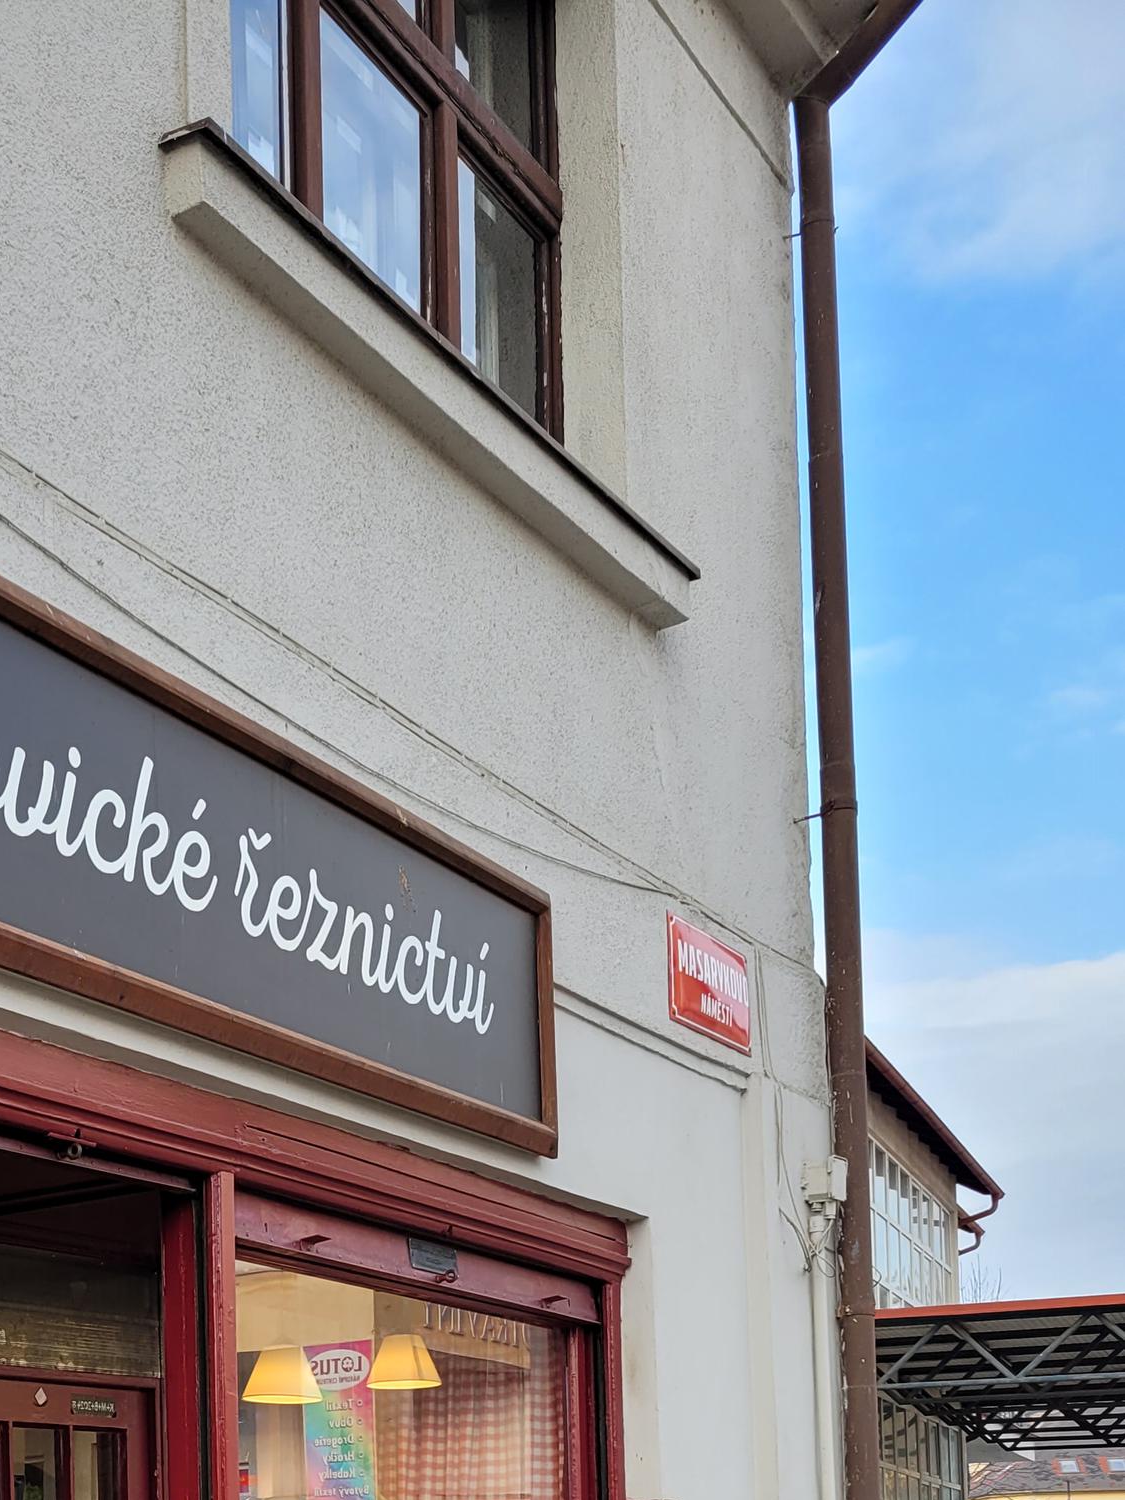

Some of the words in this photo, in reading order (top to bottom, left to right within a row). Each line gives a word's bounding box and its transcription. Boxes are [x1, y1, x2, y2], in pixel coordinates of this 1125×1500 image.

[234, 826, 496, 1035] řeznictví
[677, 938, 749, 1007] MASARYKOVO
[700, 992, 734, 1028] NÁMĚSTÍ
